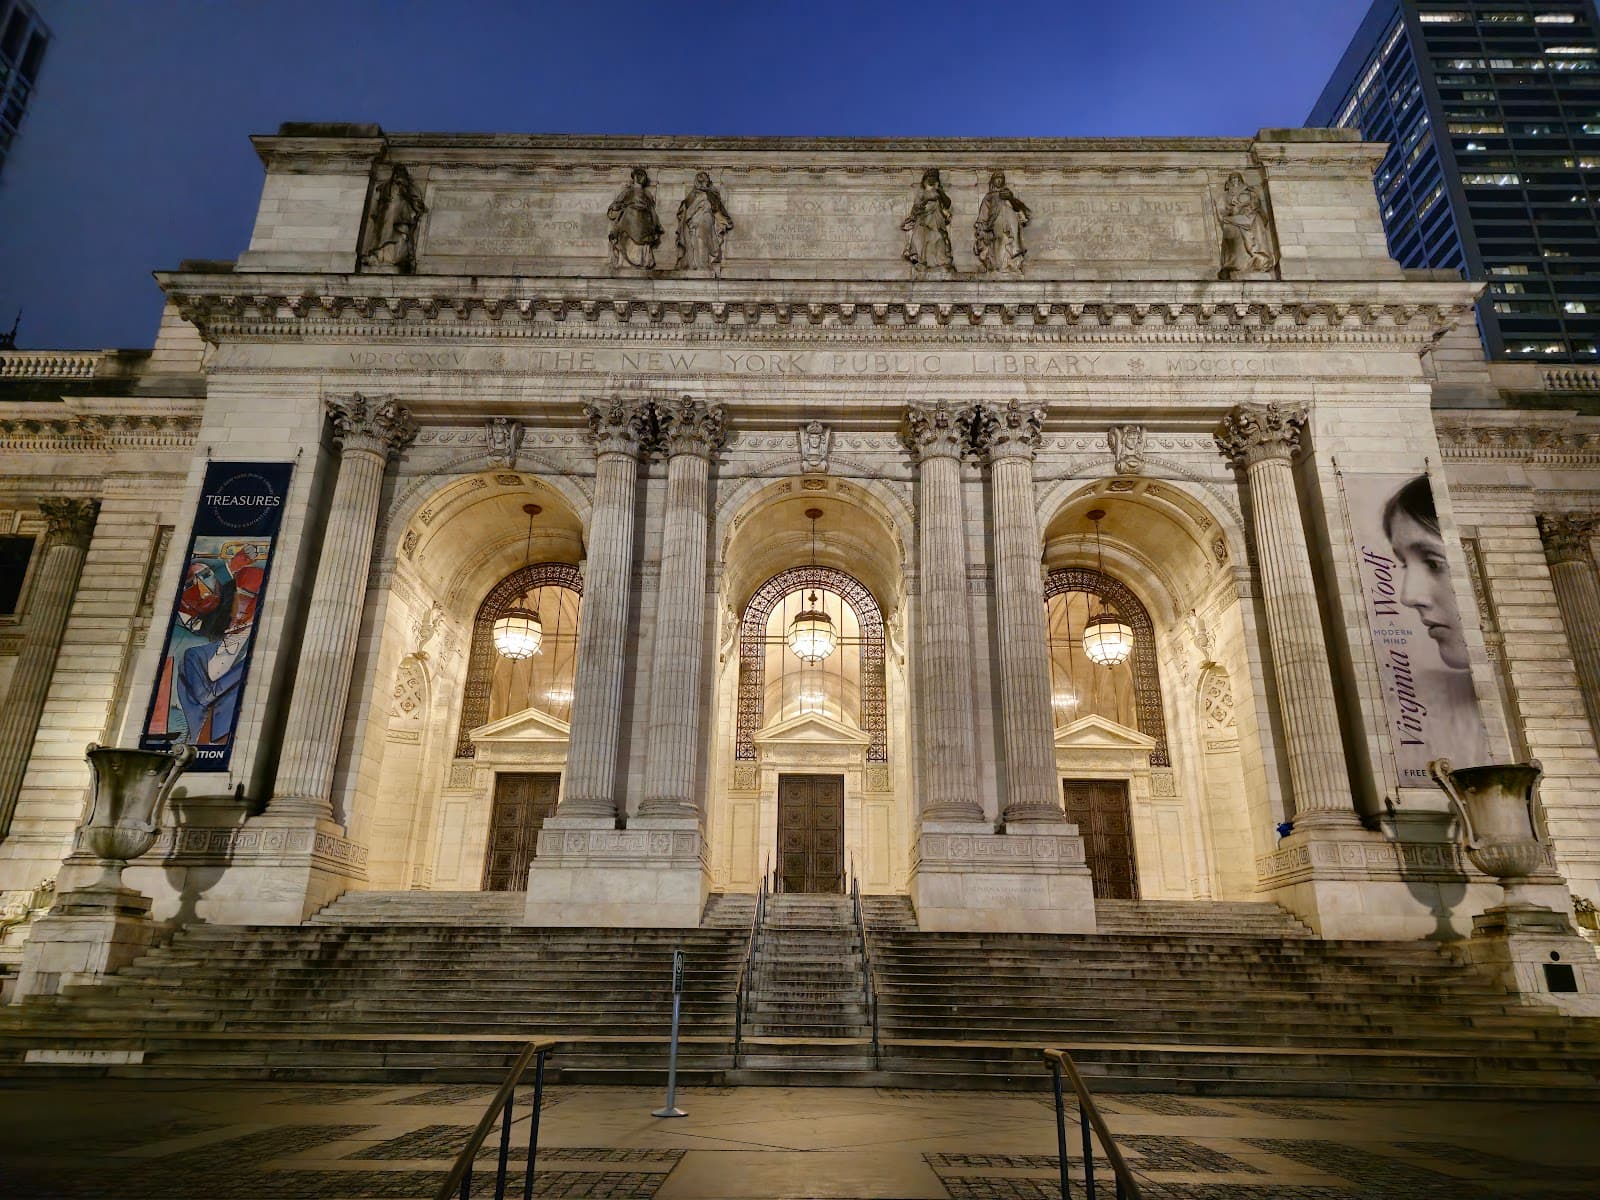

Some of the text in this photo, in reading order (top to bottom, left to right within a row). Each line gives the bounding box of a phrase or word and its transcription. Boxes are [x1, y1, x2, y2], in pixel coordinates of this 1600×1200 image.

[484, 199, 529, 209] ASTOR
[1142, 202, 1193, 212] TRUST
[349, 352, 465, 366] MDCCCXCV
[535, 352, 596, 370] THE
[621, 353, 697, 371] NEW
[727, 354, 806, 372] YORK
[832, 354, 942, 373] PUBLIC
[972, 352, 1101, 374] LIBRARY
[206, 495, 280, 507] TREASURES
[1361, 545, 1400, 616] Woolf
[1385, 649, 1427, 746] Virginia
[1404, 769, 1427, 777] FREE
